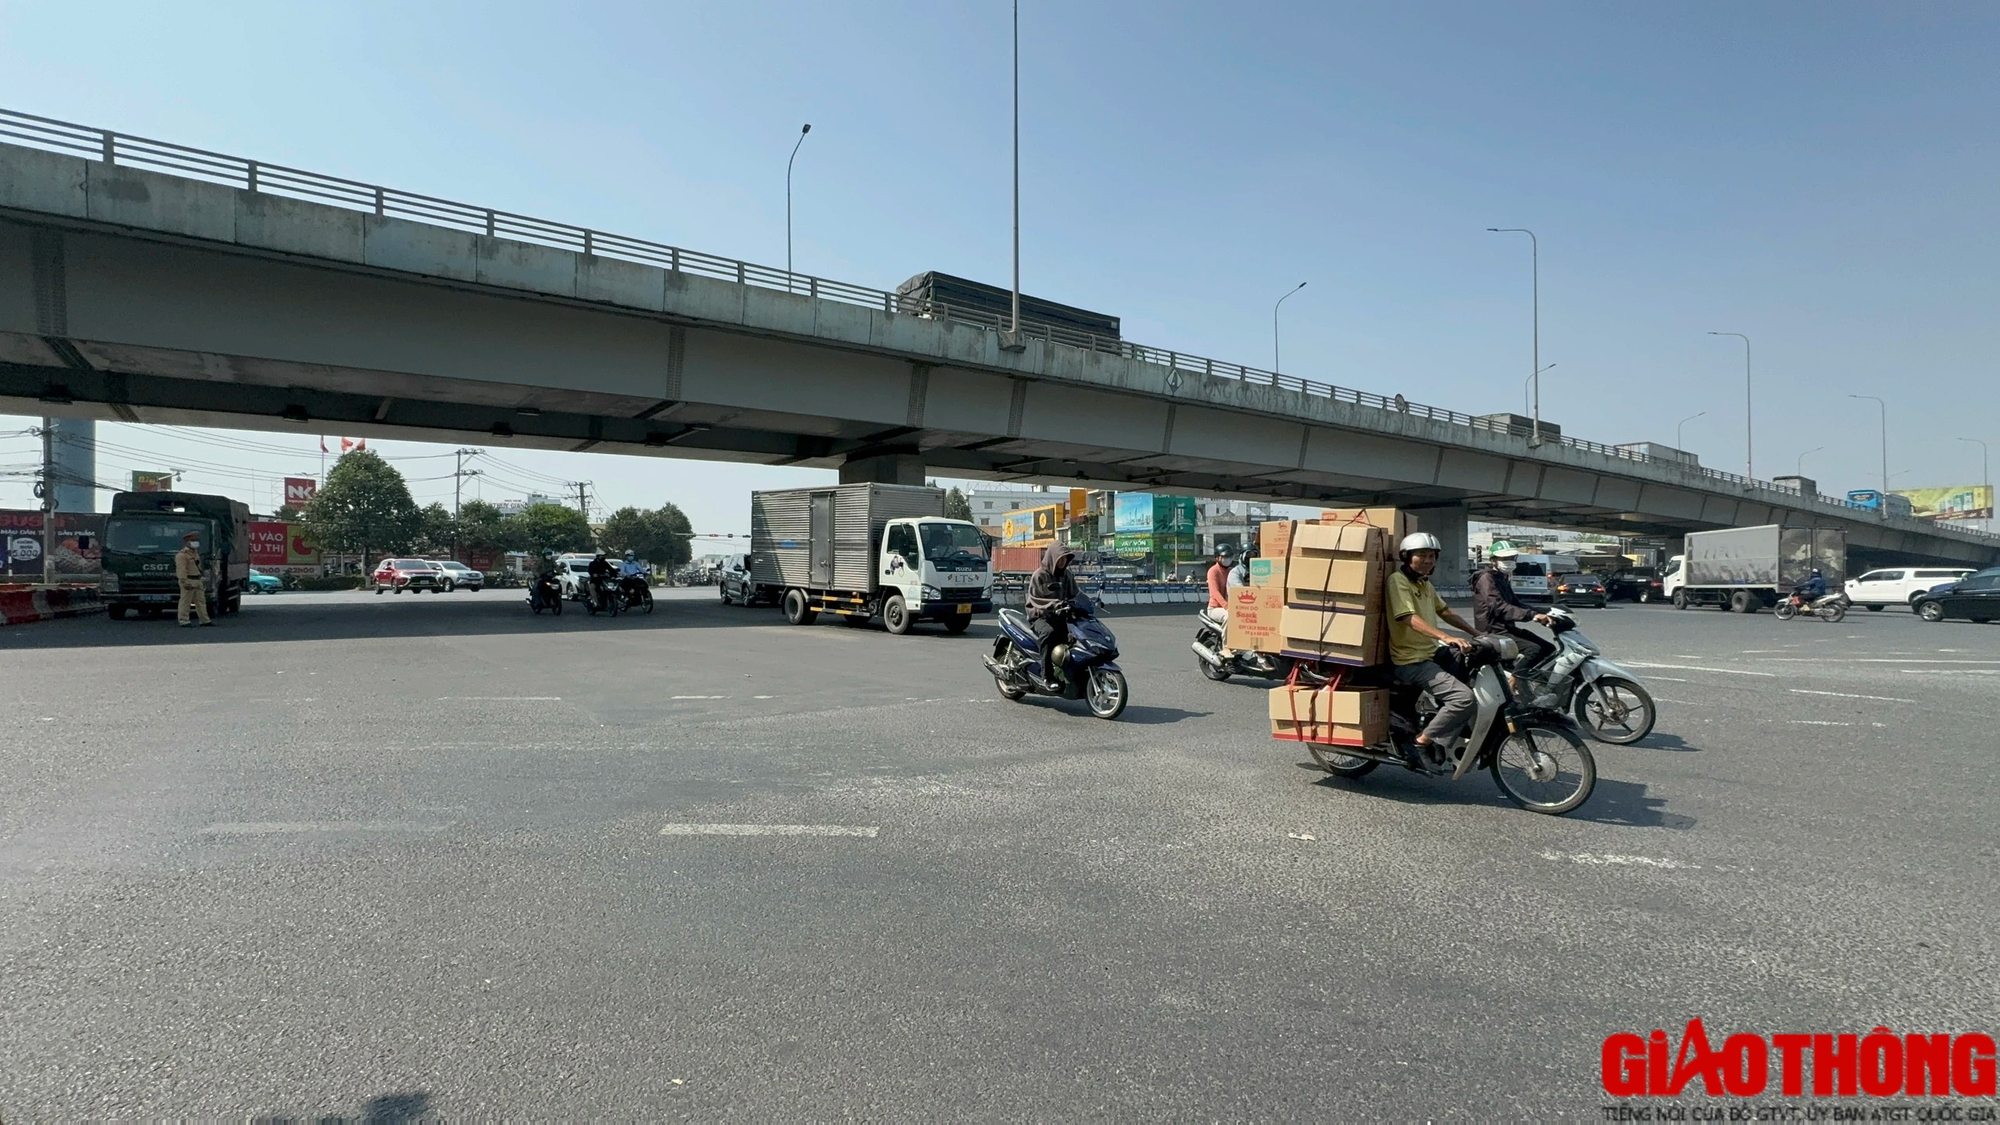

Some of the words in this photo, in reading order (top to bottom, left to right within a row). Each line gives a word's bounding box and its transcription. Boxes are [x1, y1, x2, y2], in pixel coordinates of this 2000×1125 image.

[287, 485, 313, 499] NK
[259, 531, 284, 542] VÀO
[265, 544, 284, 554] THỊ
[142, 563, 170, 571] CSGT
[954, 574, 974, 582] LTS
